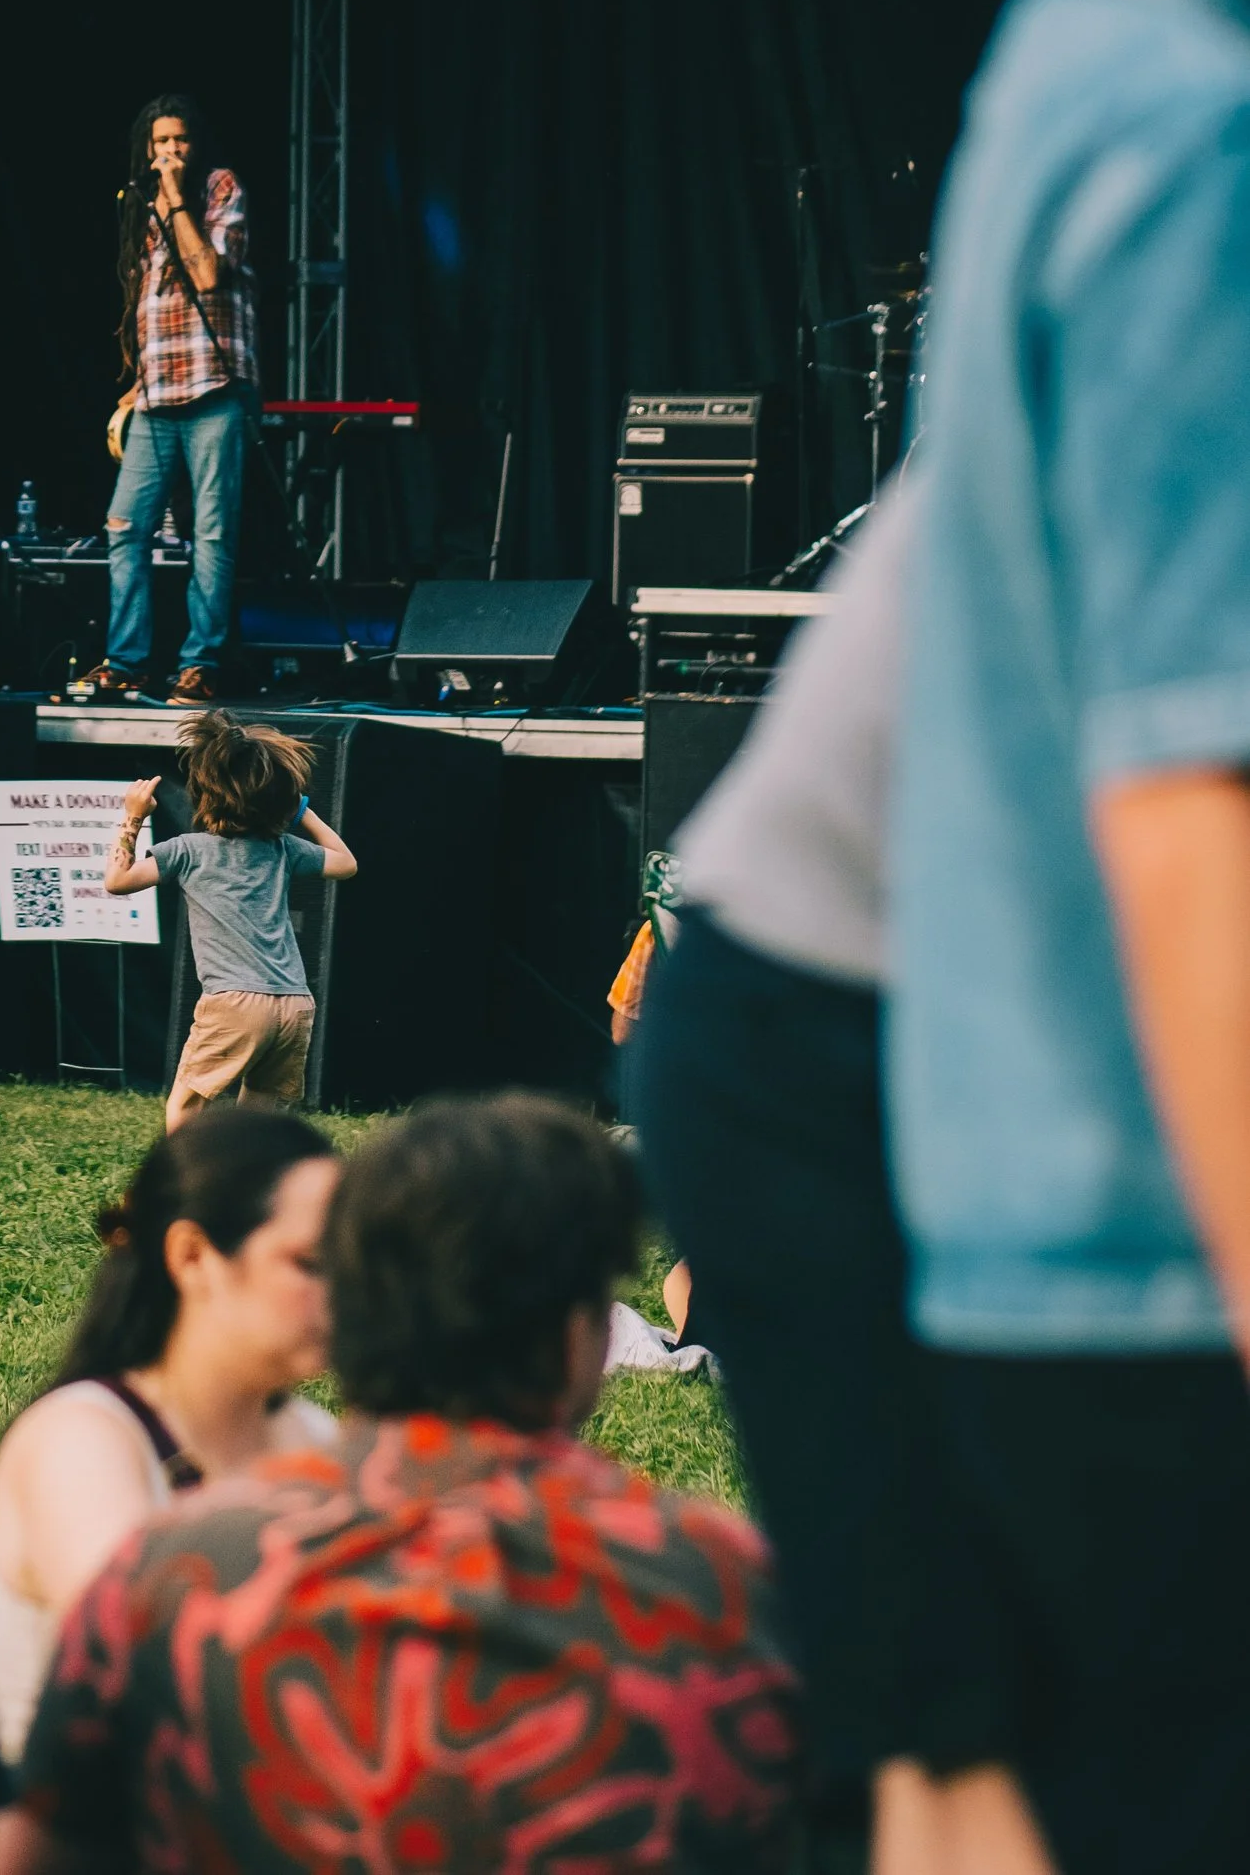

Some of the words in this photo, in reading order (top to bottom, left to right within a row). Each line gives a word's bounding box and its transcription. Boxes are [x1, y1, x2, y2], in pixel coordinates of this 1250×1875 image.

[10, 794, 50, 809] MAKE
[54, 794, 64, 809] A
[66, 794, 126, 809] DONATIO
